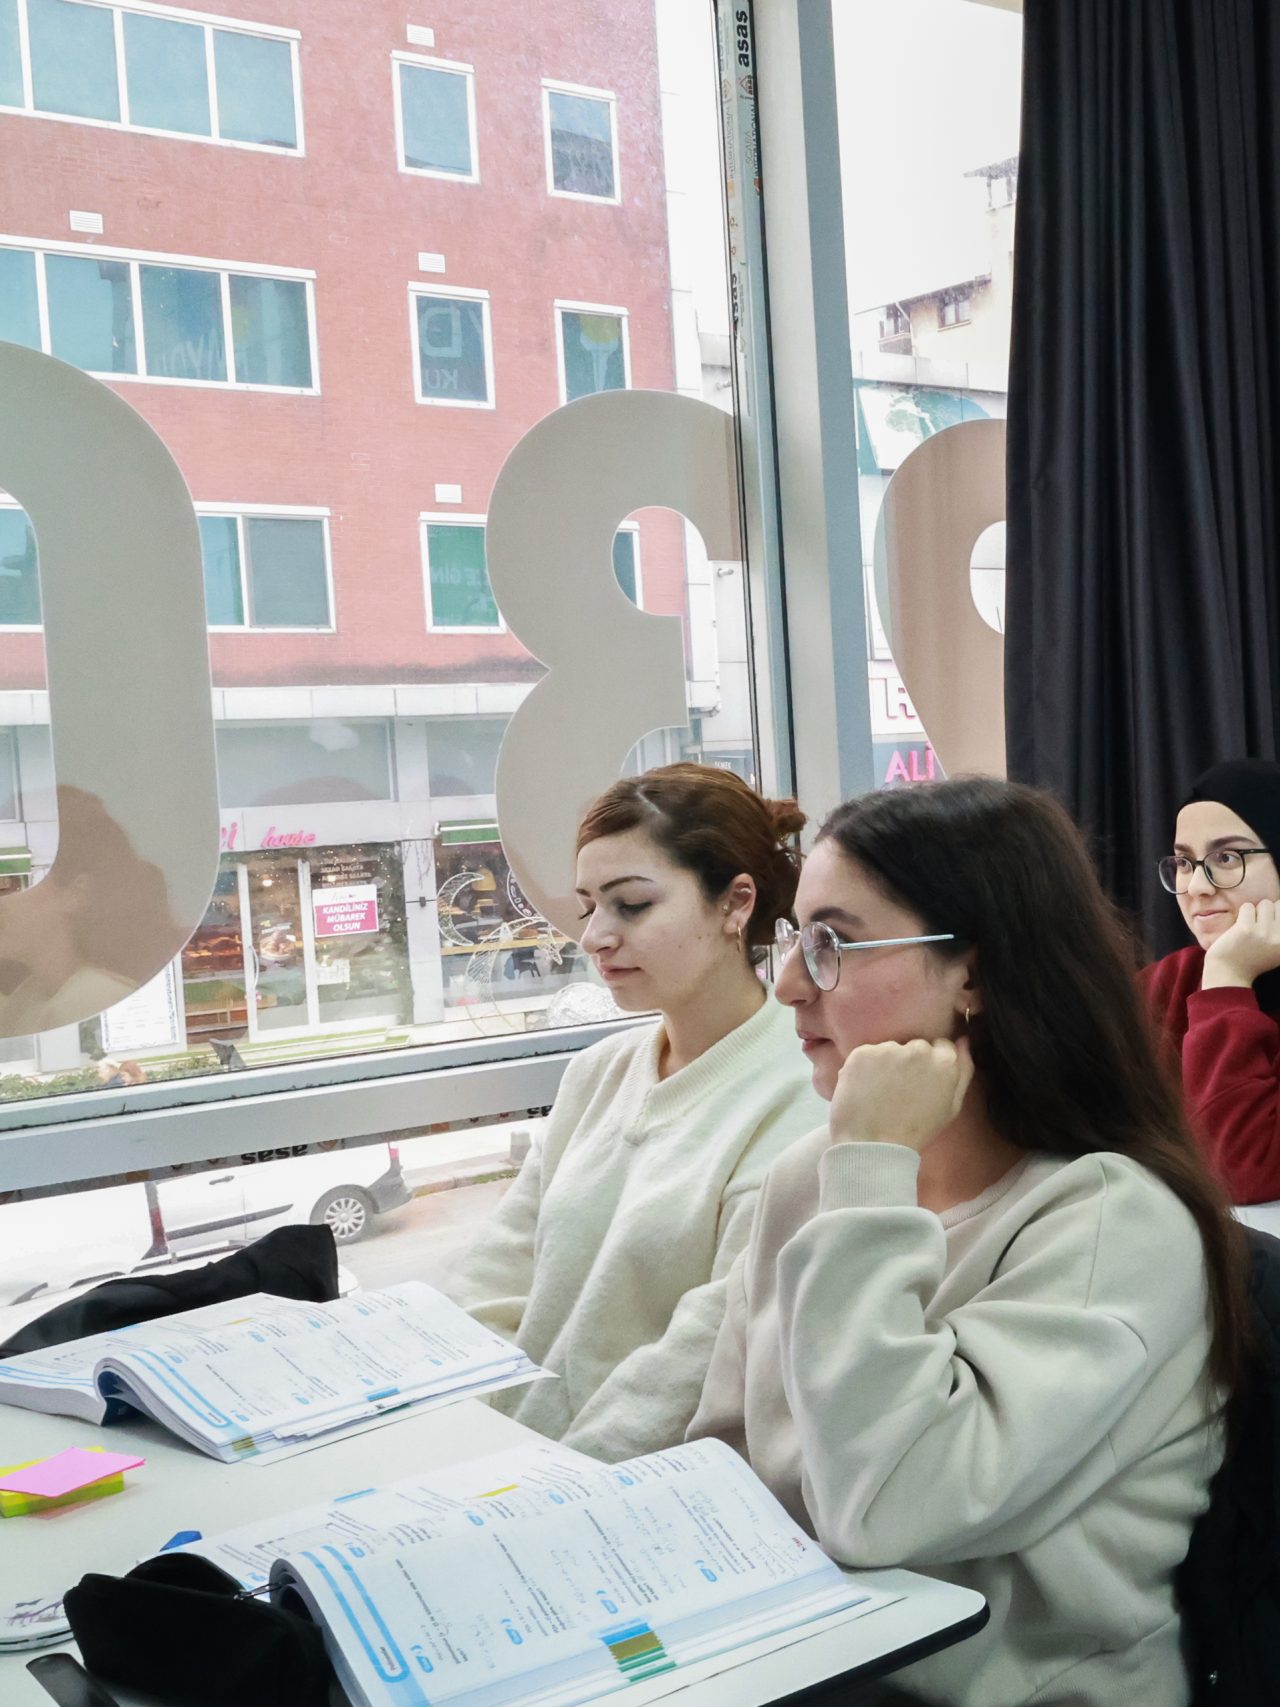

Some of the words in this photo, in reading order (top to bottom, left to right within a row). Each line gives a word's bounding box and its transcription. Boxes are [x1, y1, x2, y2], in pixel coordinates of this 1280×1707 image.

[322, 902, 369, 915] KANDİLİNİZ
[326, 912, 366, 923] MÜBAREK
[333, 921, 361, 931] OLSUN
